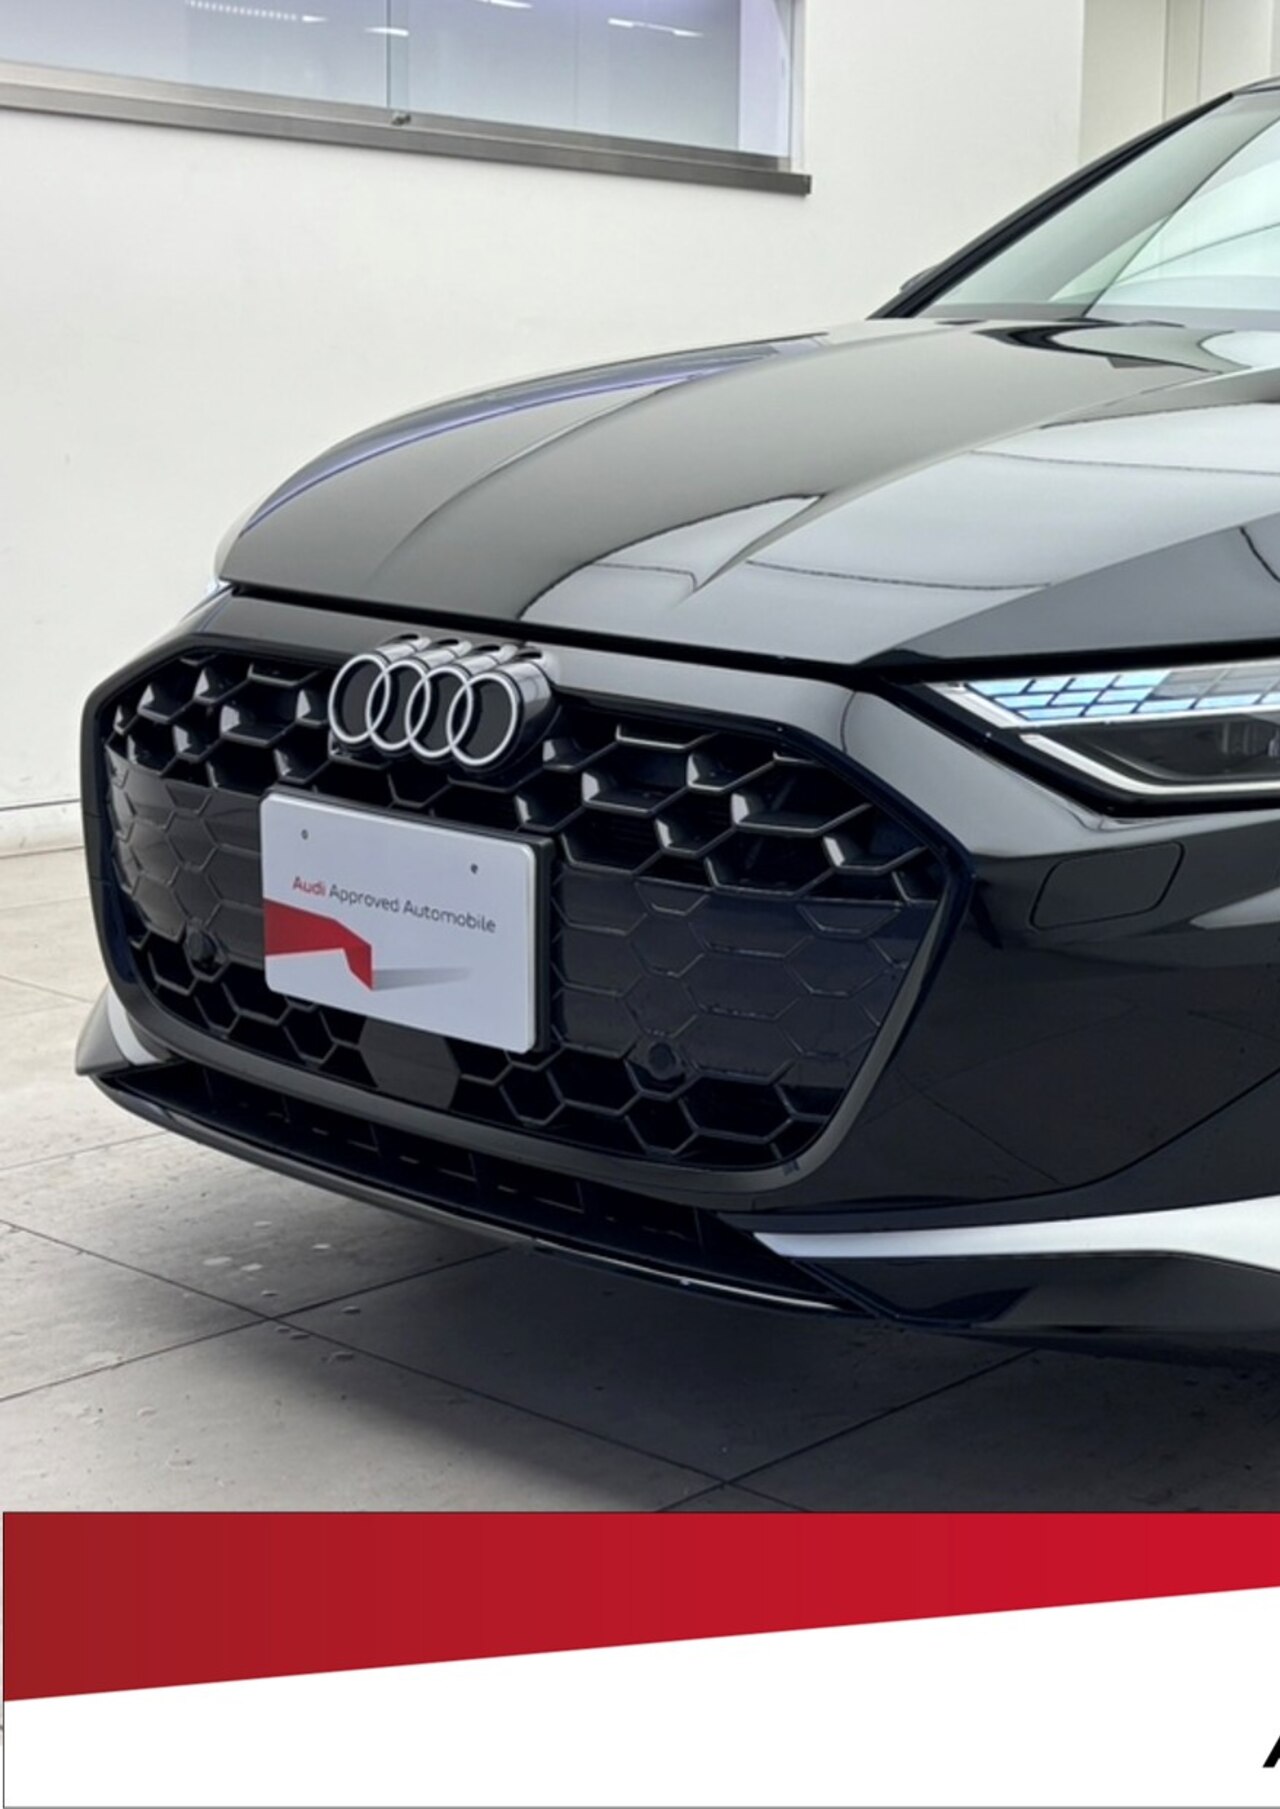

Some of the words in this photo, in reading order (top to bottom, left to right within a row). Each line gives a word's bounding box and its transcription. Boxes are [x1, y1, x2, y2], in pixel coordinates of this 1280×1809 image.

[292, 876, 326, 896] Audi
[329, 884, 400, 913] Approved
[403, 900, 496, 933] Automobile
